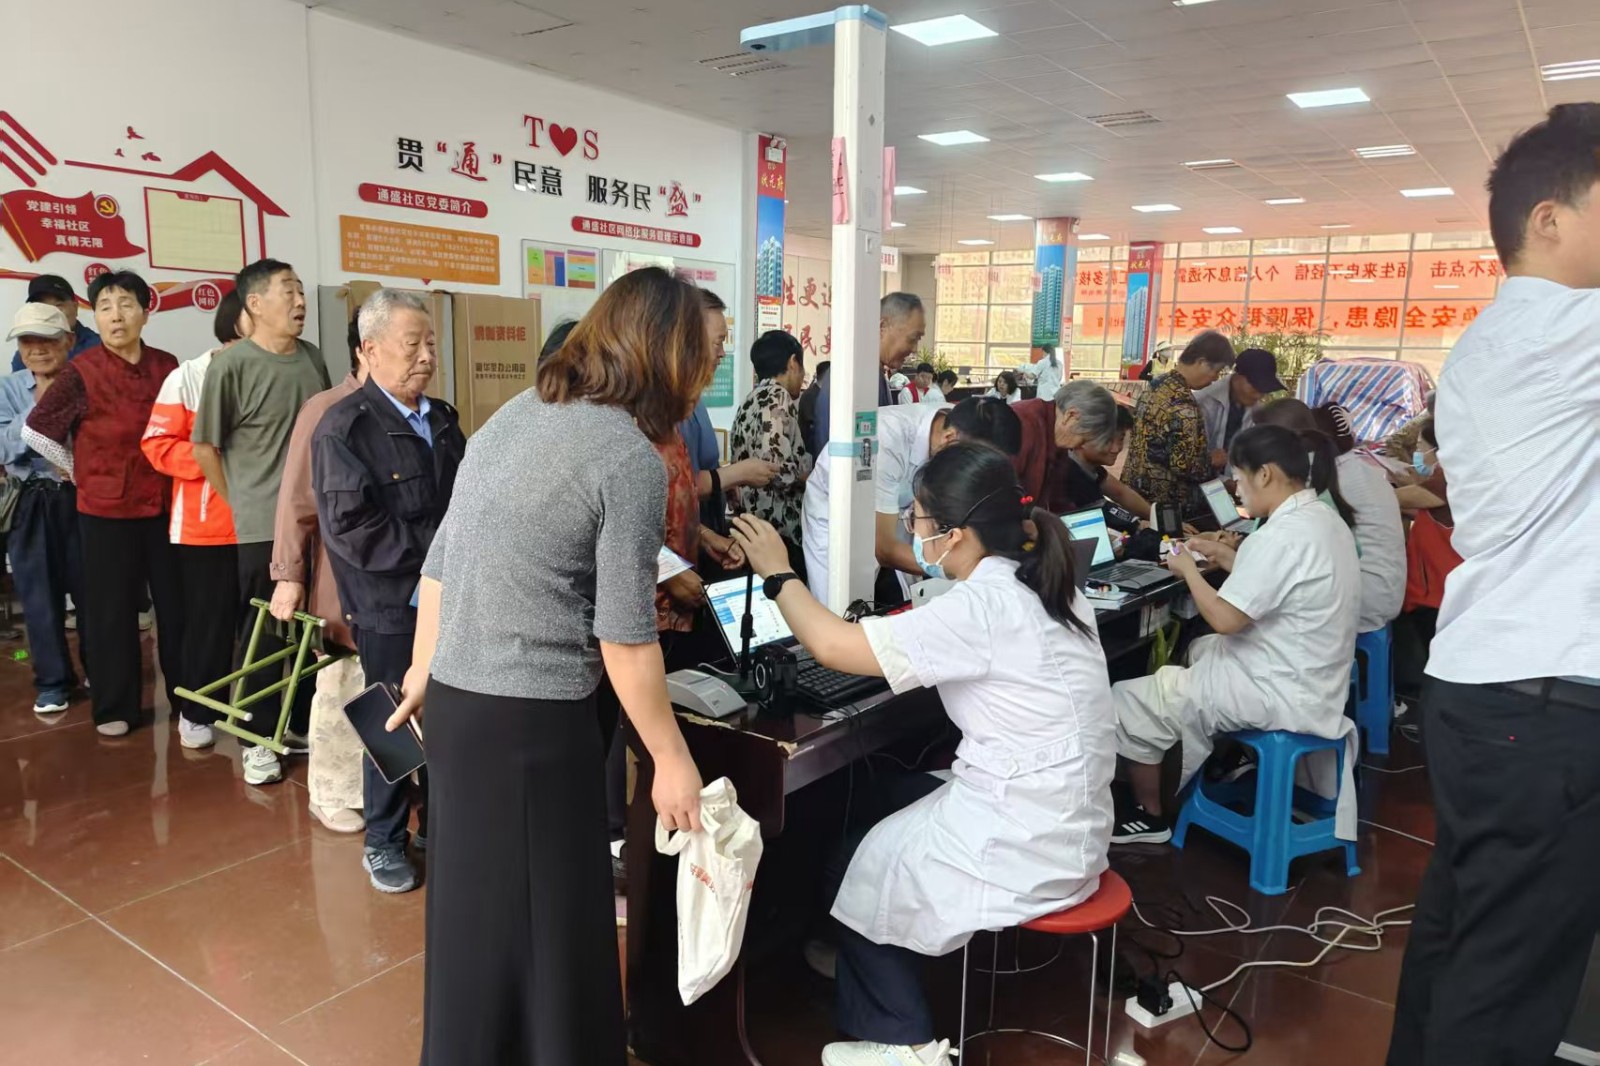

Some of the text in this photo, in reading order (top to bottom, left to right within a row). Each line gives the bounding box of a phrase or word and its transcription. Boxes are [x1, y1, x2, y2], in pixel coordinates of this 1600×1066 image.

[26, 200, 77, 215] 党建引领
[377, 187, 472, 214] 通盛社区党委简介
[41, 217, 91, 232] 幸福社区
[55, 234, 103, 248] 真情无限
[198, 288, 215, 297] 红色
